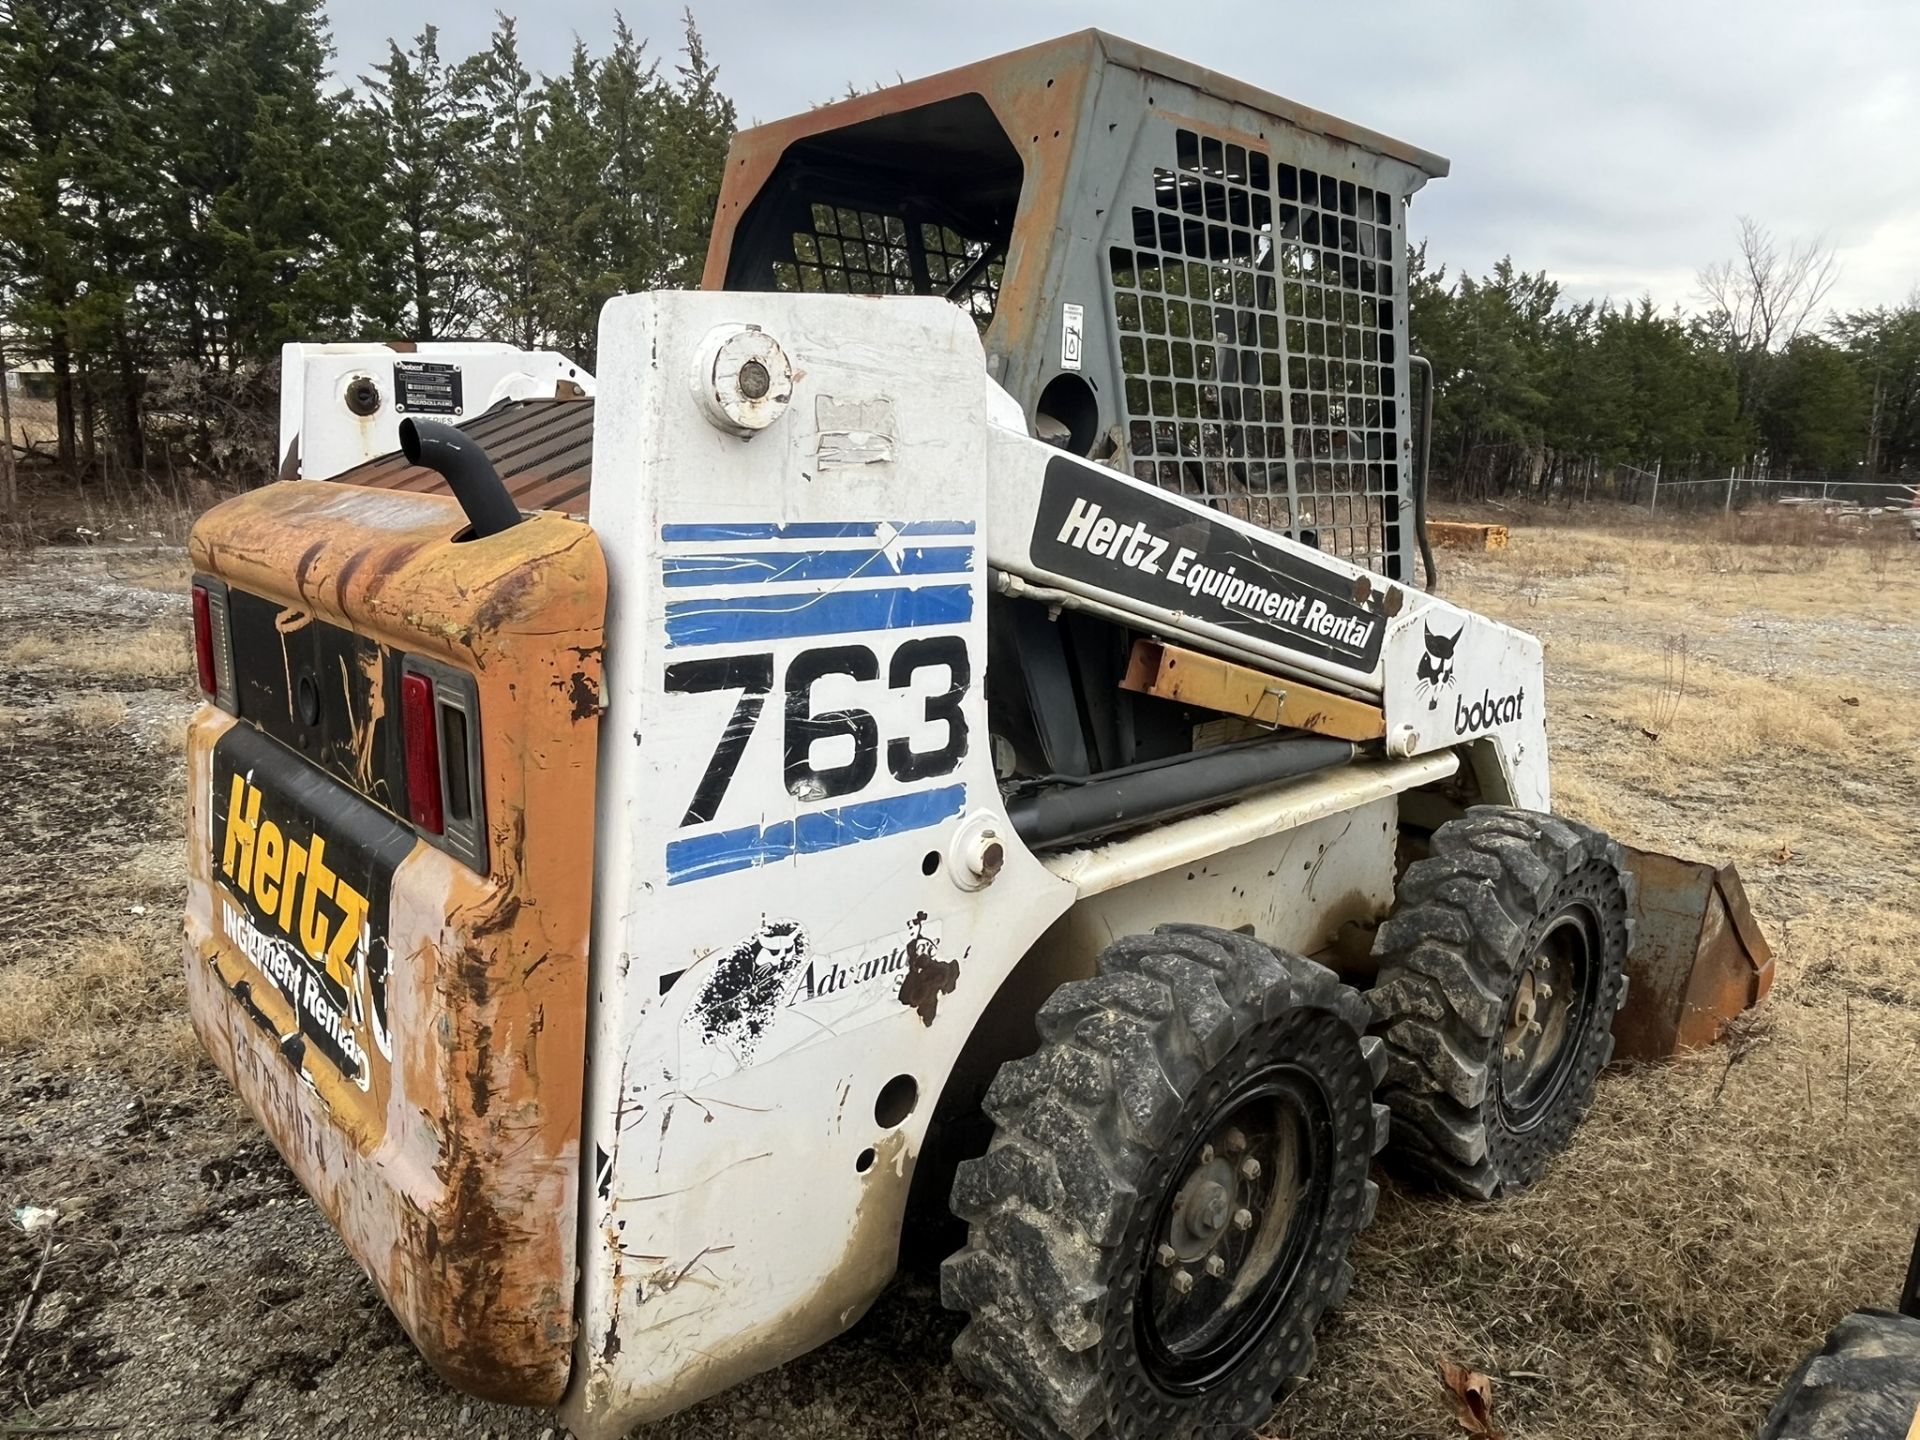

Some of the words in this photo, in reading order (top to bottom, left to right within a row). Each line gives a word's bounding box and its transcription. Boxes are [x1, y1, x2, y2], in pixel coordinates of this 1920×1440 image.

[1056, 497, 1170, 575] Hertz
[1165, 546, 1307, 622] Equipment
[1302, 599, 1376, 650] Rental
[663, 634, 971, 828] 763
[1454, 685, 1525, 736] bobcat
[222, 772, 370, 989] Hertz
[302, 972, 360, 1067] Renta
[786, 937, 941, 1008] Advantae
